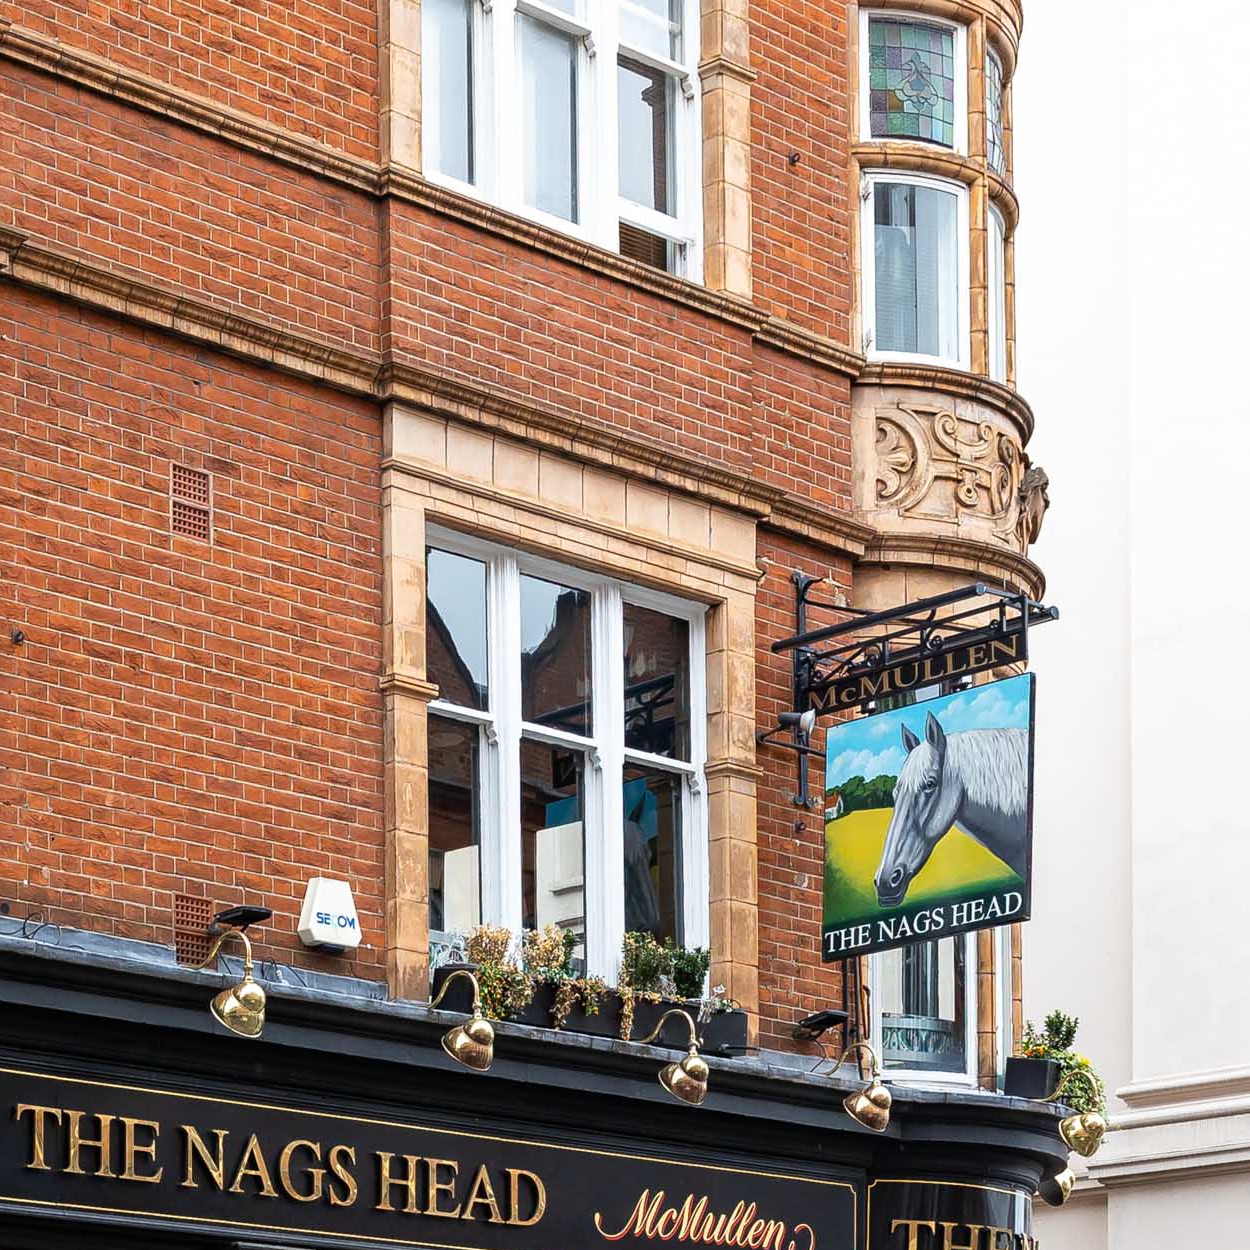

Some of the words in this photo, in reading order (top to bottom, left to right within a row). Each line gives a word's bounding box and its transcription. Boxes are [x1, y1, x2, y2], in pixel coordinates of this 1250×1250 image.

[808, 634, 1019, 711] McMULLEN
[316, 911, 356, 930] SEOM
[824, 924, 871, 954] THE
[877, 906, 944, 943] NAGS
[951, 891, 1023, 926] HEAD
[15, 1102, 164, 1185] THE
[180, 1124, 358, 1208] NAGS
[374, 1150, 548, 1227] HEAD
